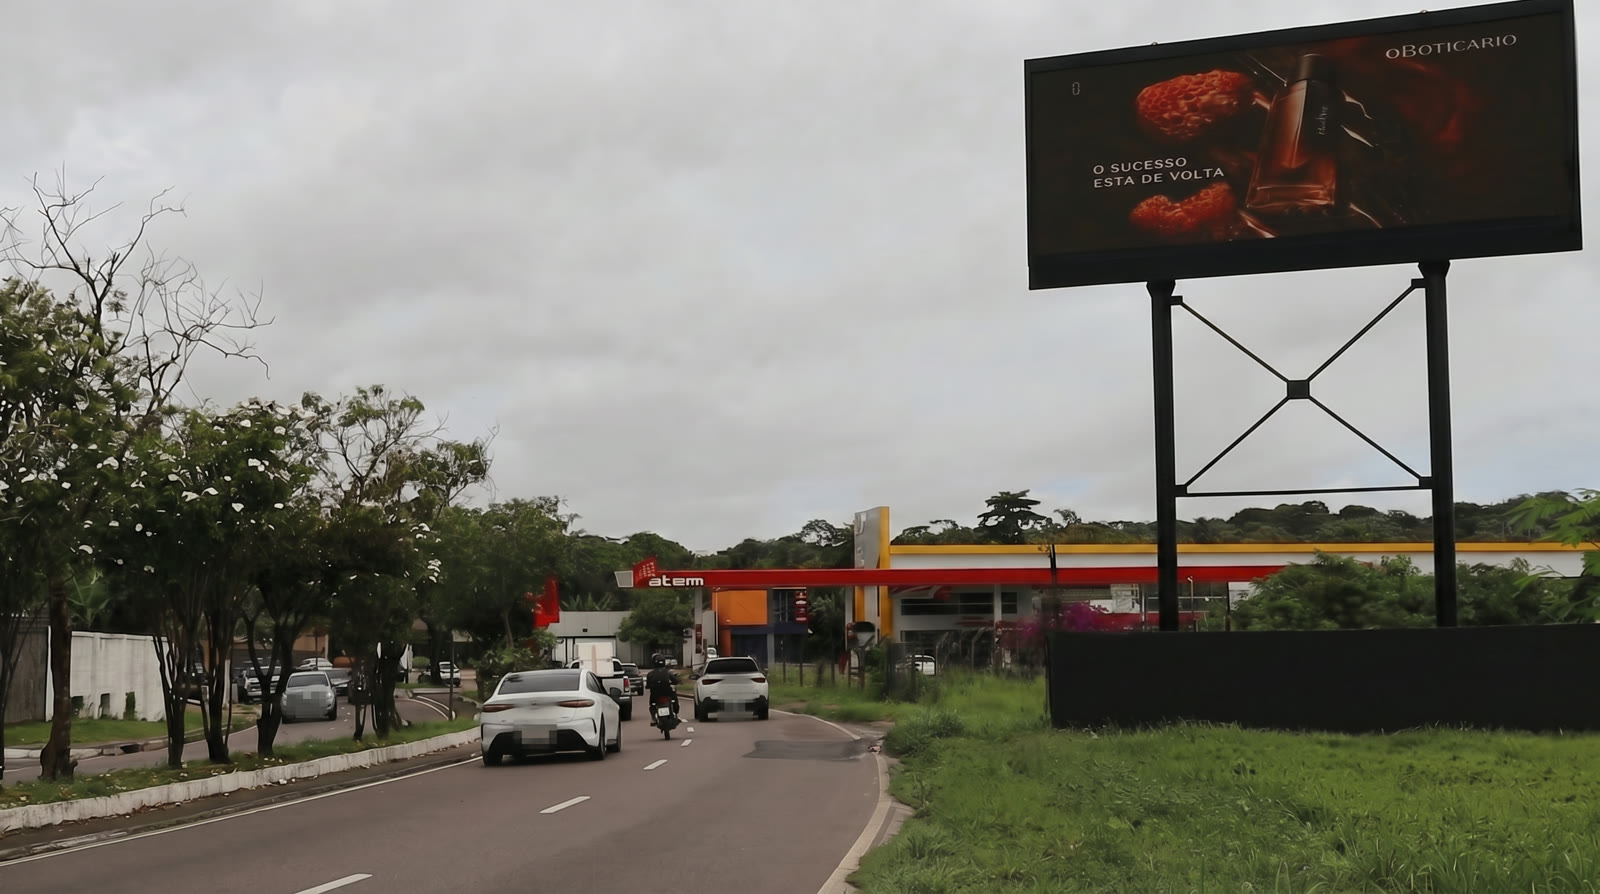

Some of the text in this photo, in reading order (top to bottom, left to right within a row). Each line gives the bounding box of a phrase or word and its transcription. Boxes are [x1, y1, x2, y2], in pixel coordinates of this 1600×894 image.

[1093, 157, 1187, 175] O SUCESSO
[1094, 167, 1225, 188] ESTA DE VOLTA
[648, 575, 704, 587] atem
